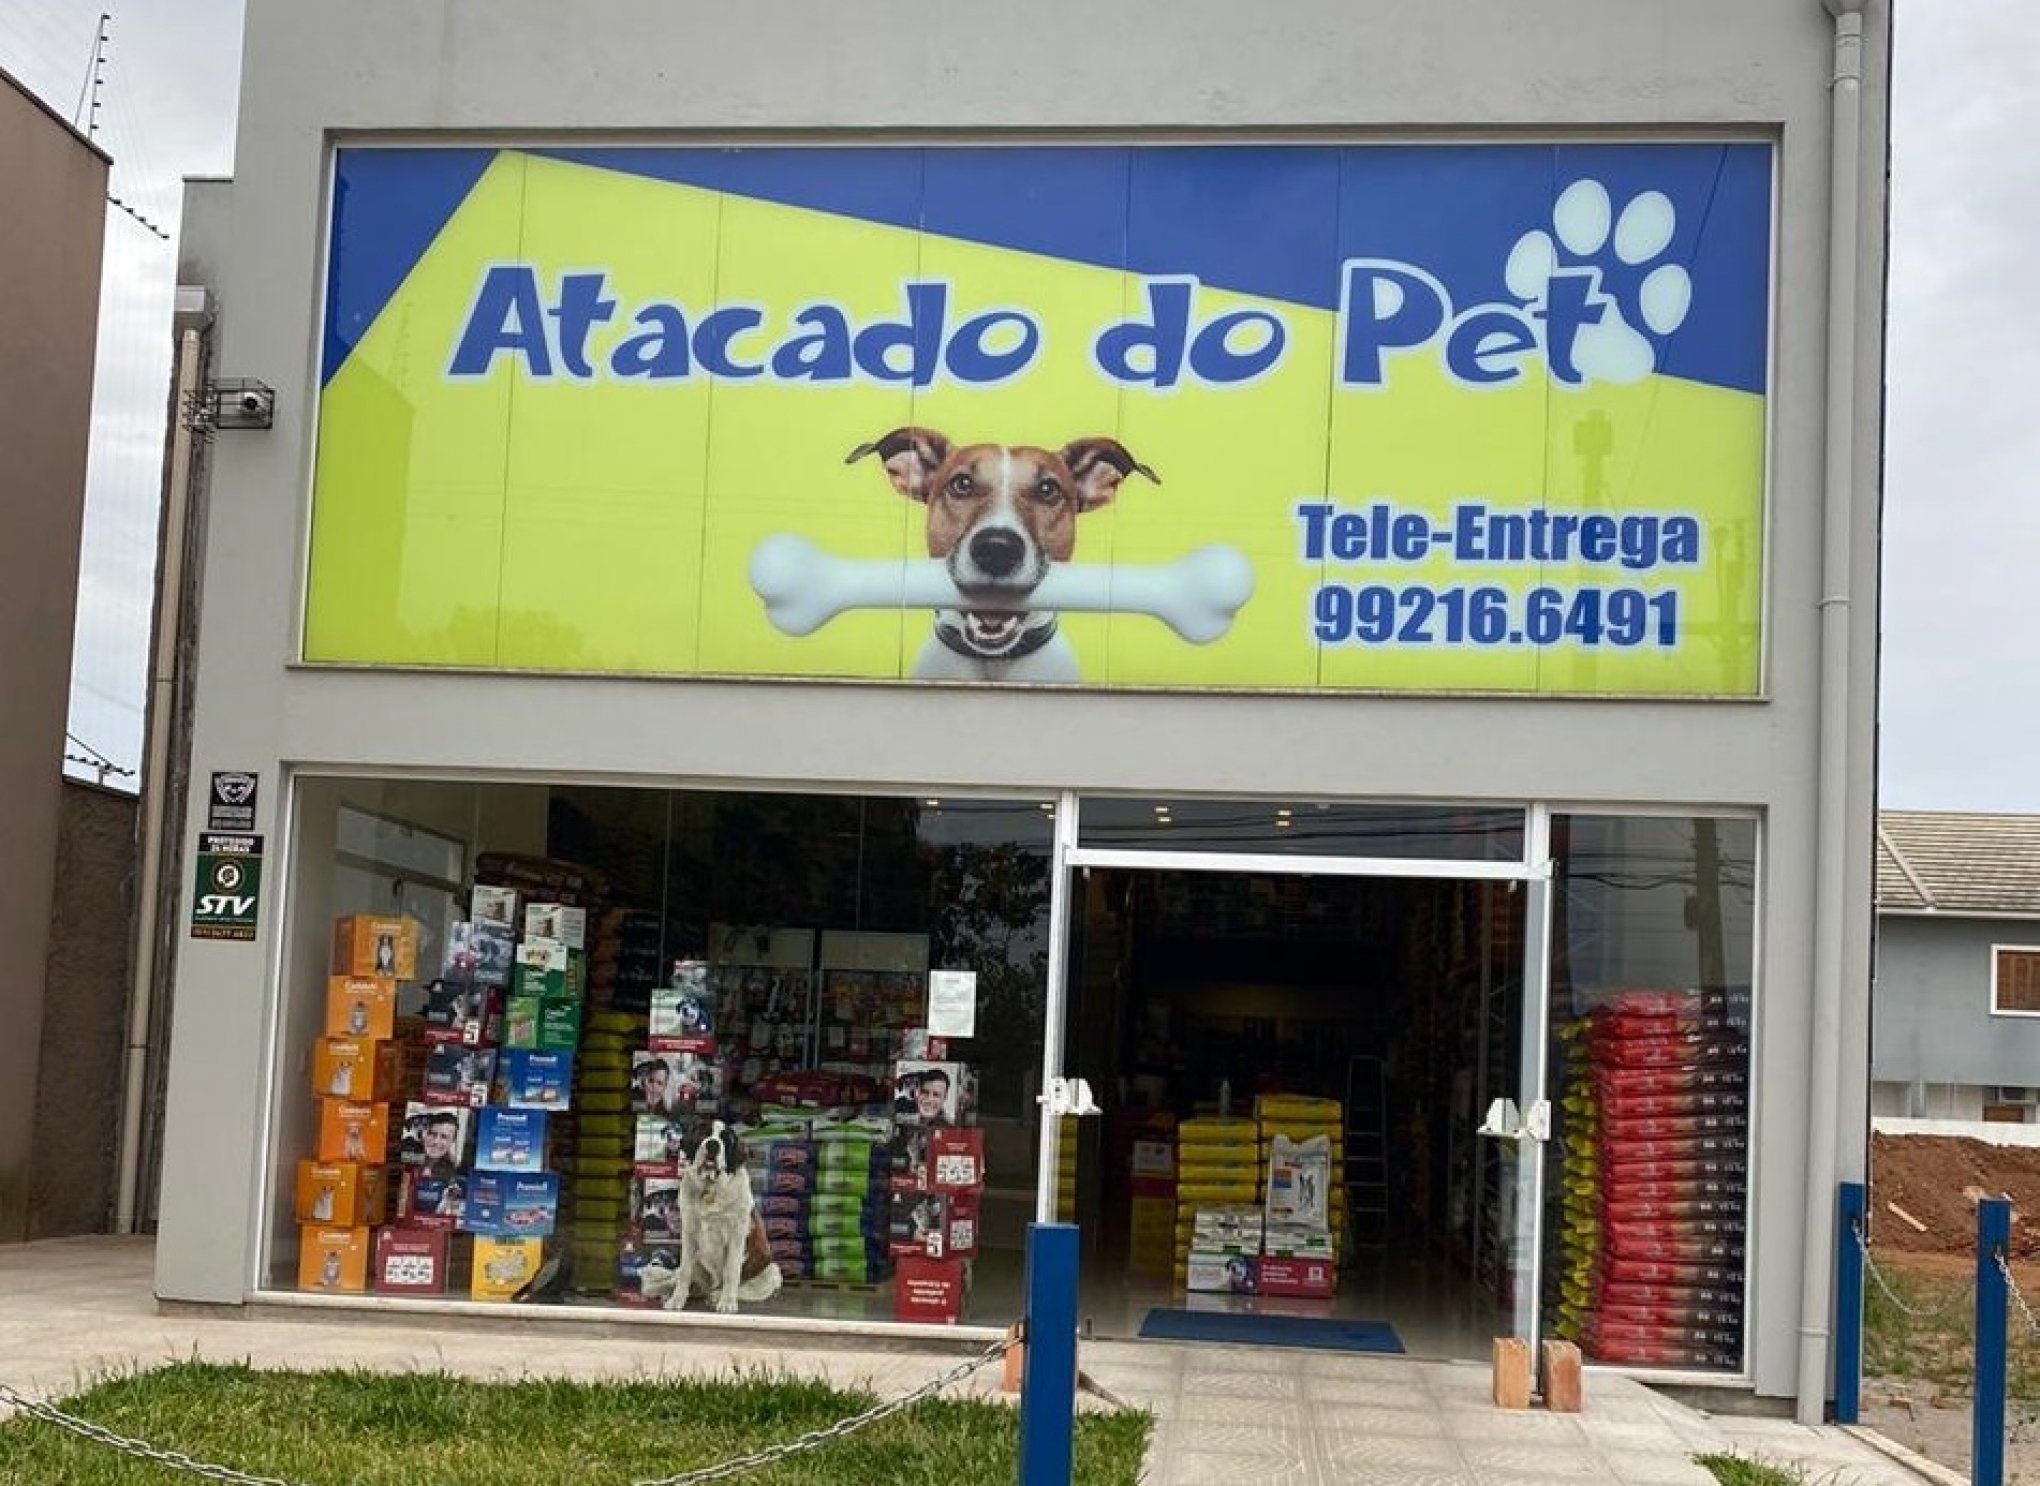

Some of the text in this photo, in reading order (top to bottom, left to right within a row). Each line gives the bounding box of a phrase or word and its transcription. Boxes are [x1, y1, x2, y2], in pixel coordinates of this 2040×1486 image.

[446, 265, 1609, 387] Atacado do Pet
[1298, 504, 1699, 569] Tele-Entrega
[1314, 585, 1677, 647] 99216.6491
[196, 894, 256, 917] STV
